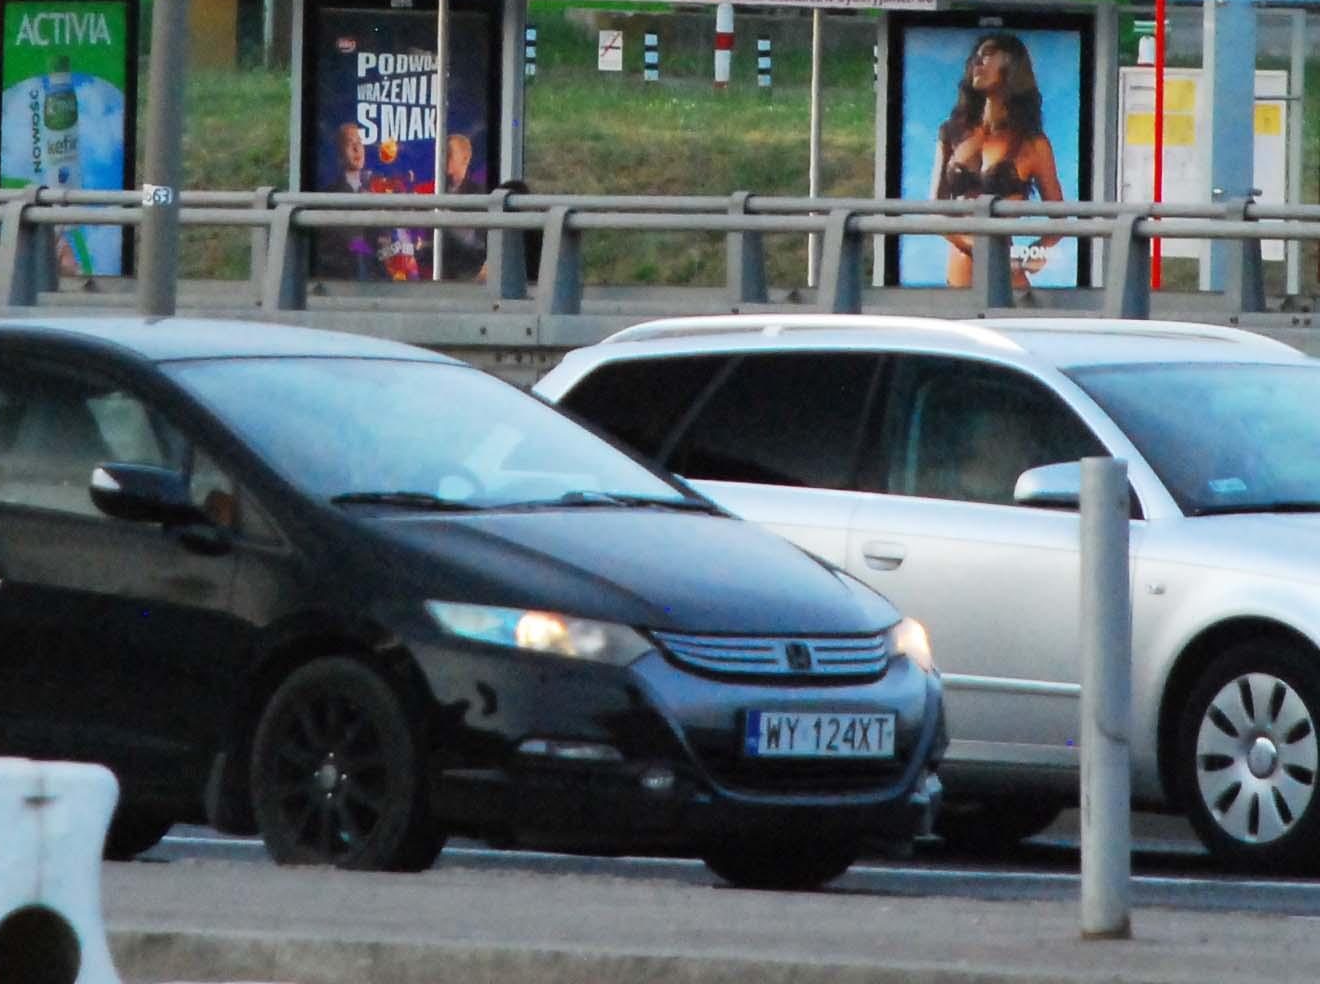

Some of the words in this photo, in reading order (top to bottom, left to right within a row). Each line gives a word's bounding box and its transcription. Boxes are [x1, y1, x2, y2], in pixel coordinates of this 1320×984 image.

[15, 12, 111, 46] ACTIVIA
[766, 718, 799, 751] WY
[813, 718, 889, 753] 124XT
